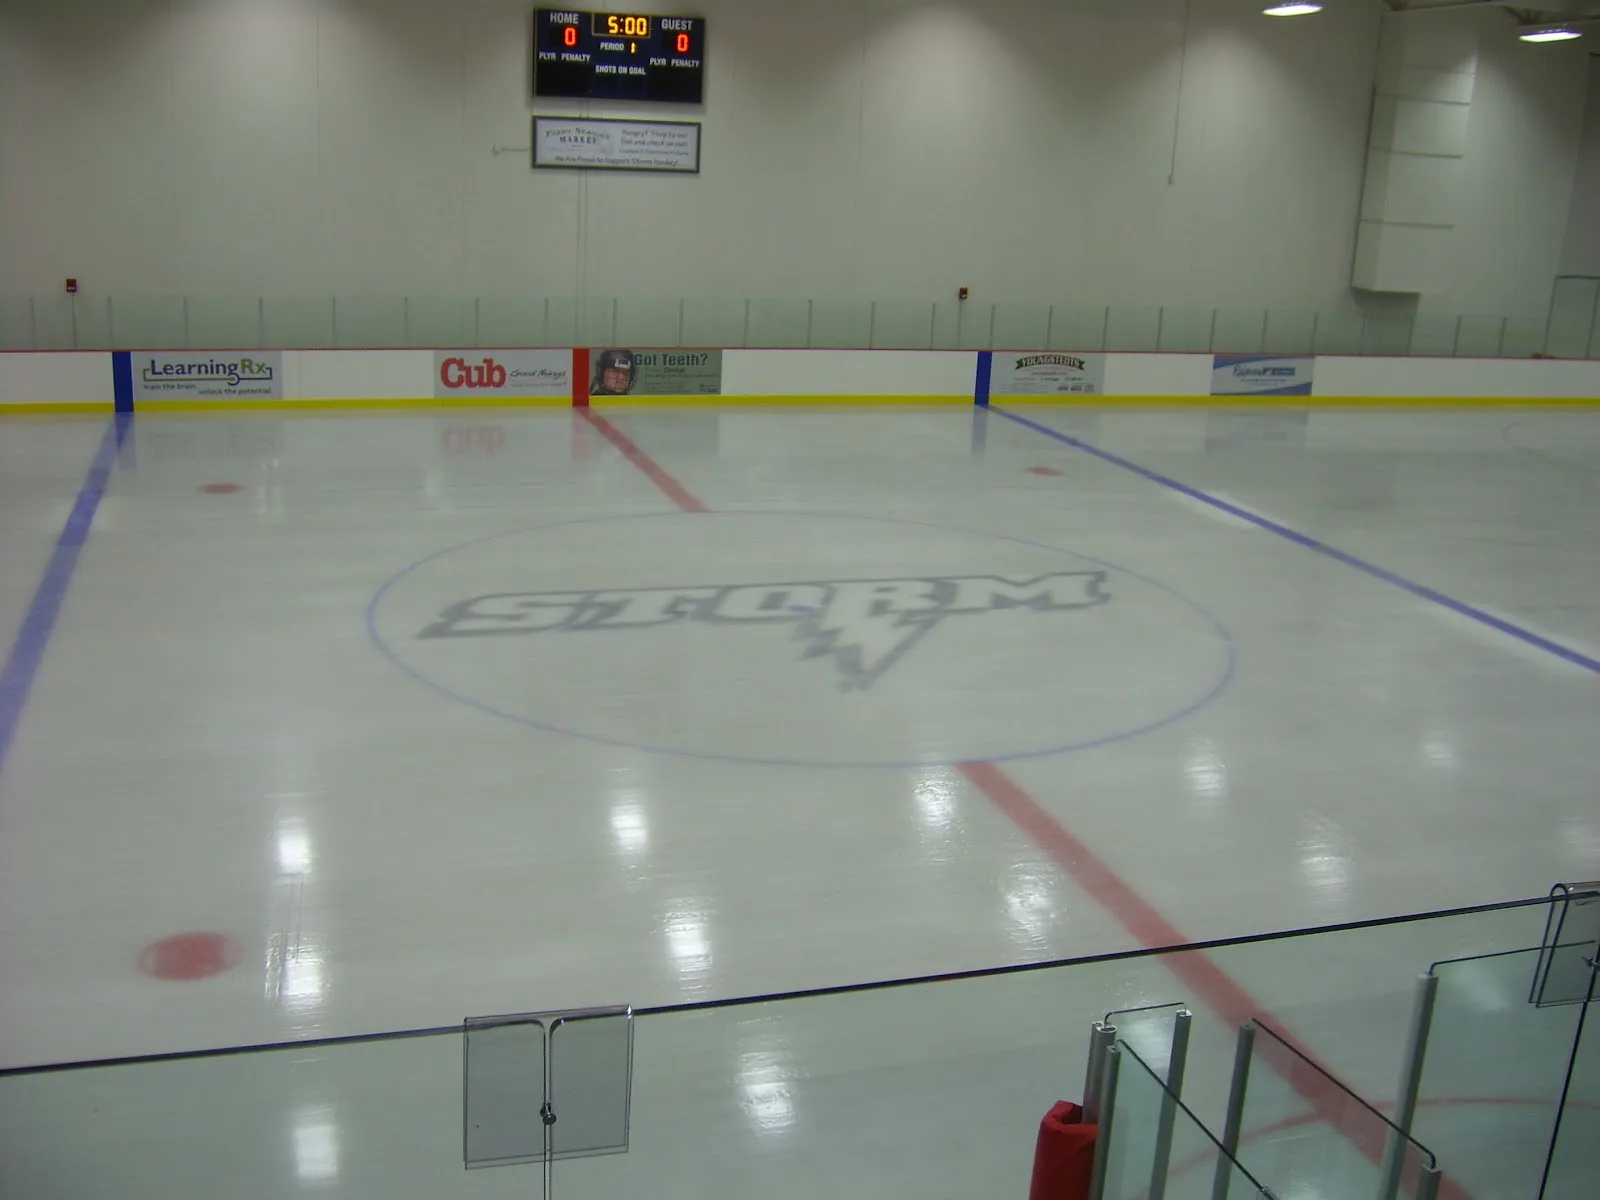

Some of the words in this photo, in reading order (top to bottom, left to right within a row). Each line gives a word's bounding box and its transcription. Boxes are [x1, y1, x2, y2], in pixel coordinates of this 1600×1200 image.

[549, 12, 579, 25] HOME
[661, 18, 693, 31] GUEST
[607, 15, 648, 36] 5:00
[564, 27, 576, 46] 0
[677, 33, 689, 52] 0
[600, 42, 625, 51] PERIOD
[538, 52, 557, 61] PLYR
[561, 52, 591, 63] PENALTY
[649, 57, 667, 66] PLYR
[671, 58, 700, 68] PENALTY
[595, 65, 617, 74] SHOTS
[617, 65, 628, 74] ON
[628, 66, 646, 75] GOAL
[559, 135, 597, 144] MARKET
[634, 353, 657, 366] Got
[661, 352, 708, 366] Teeth?
[150, 357, 267, 381] LearningRx
[440, 357, 507, 389] Cub
[162, 382, 176, 390] the
[420, 571, 1110, 678] STORM
